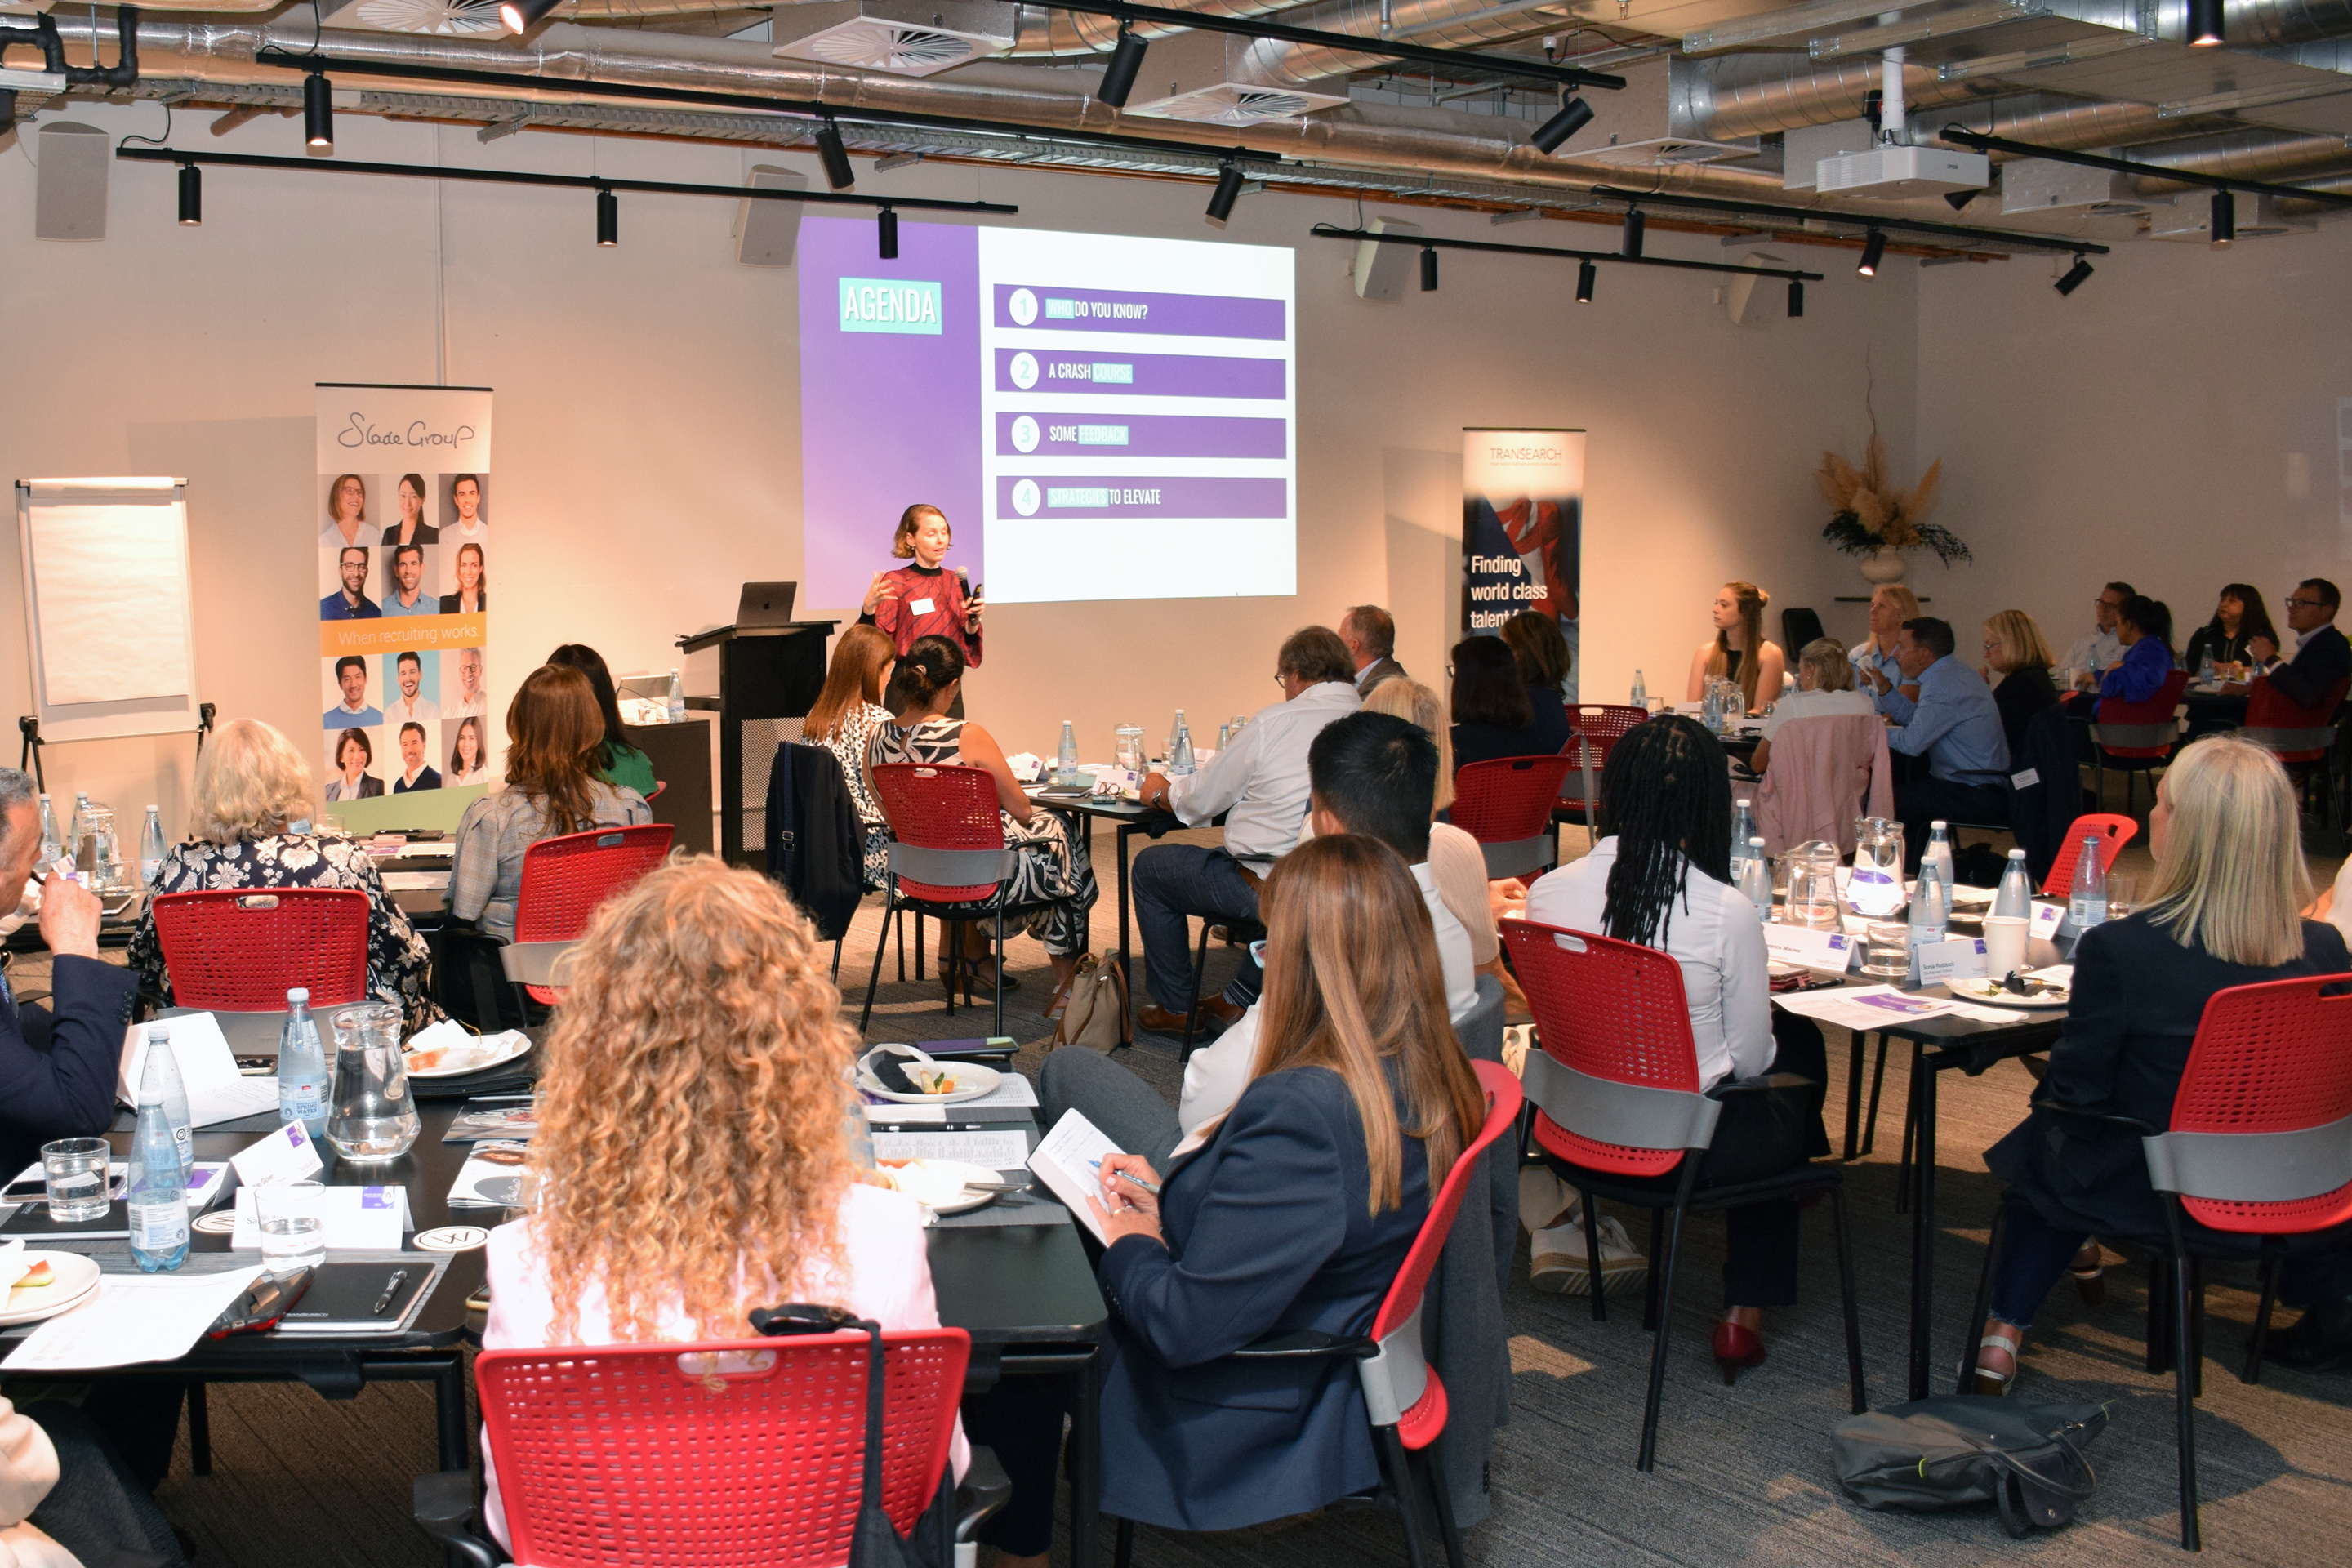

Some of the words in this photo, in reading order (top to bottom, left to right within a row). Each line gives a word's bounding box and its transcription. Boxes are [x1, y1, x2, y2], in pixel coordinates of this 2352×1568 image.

[844, 286, 937, 323] AGENDA
[1019, 298, 1027, 316] 1
[1048, 300, 1071, 317] WHO
[1075, 301, 1089, 317] DO
[1090, 302, 1111, 318] YOU
[1112, 303, 1148, 320] KNOW?
[1019, 361, 1031, 380] 2
[1049, 363, 1056, 378] A
[1058, 363, 1091, 380] CRASH
[1093, 364, 1132, 381] COURSE
[337, 412, 403, 448] Slade
[407, 421, 475, 450] Group
[1020, 424, 1031, 443] 3
[1049, 425, 1077, 442] SOME
[1079, 425, 1127, 443] FEEDBACK
[1490, 448, 1562, 460] TRANSEARCH
[1021, 488, 1032, 506] 4
[1050, 489, 1107, 506] STRATEGIES
[1108, 489, 1121, 505] TO
[1123, 489, 1161, 505] ELEVATE
[1471, 555, 1522, 577] Finding
[1470, 582, 1509, 601] world
[1512, 581, 1548, 600] class
[338, 630, 376, 646] When
[379, 626, 438, 644] recruiting
[441, 624, 480, 639] works.
